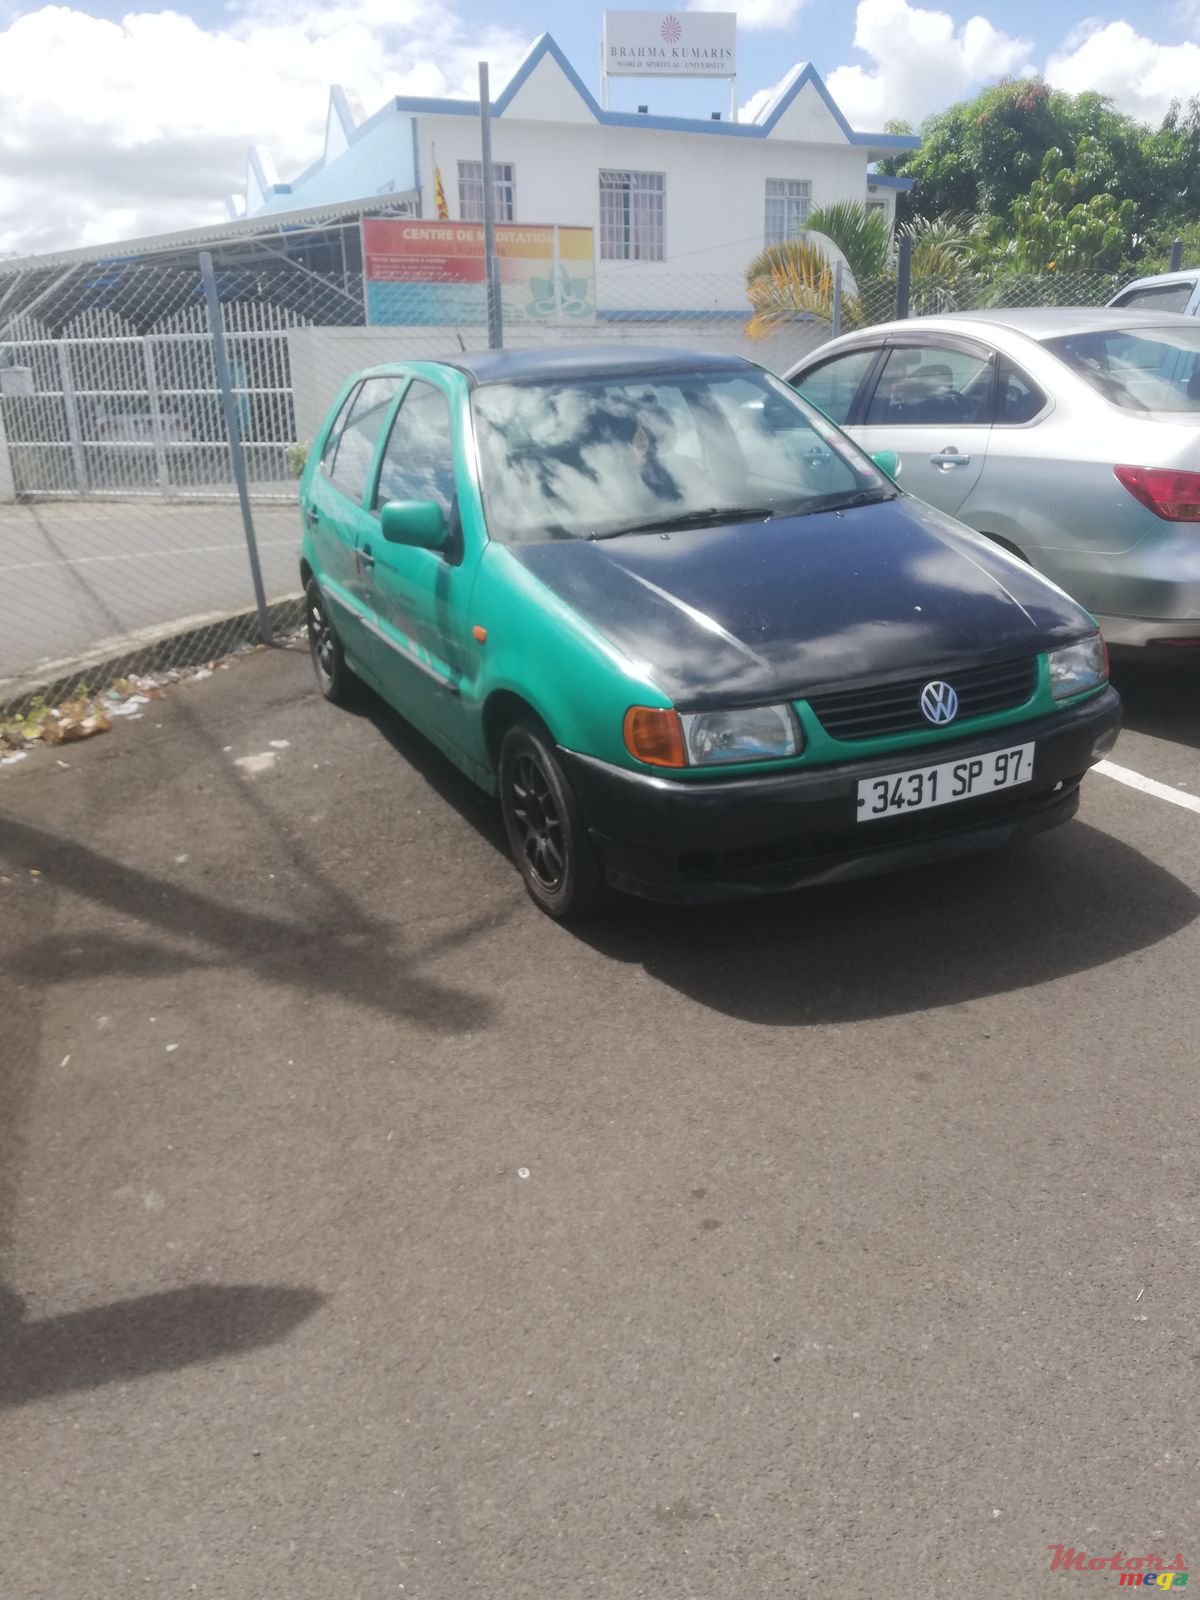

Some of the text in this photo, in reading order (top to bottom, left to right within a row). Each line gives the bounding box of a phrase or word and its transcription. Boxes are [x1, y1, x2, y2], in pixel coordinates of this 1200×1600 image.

[610, 47, 732, 58] BRAHMA KUMARIS
[402, 228, 555, 244] CENTRE DE MDITATION
[872, 749, 1023, 813] 3431 SP 97
